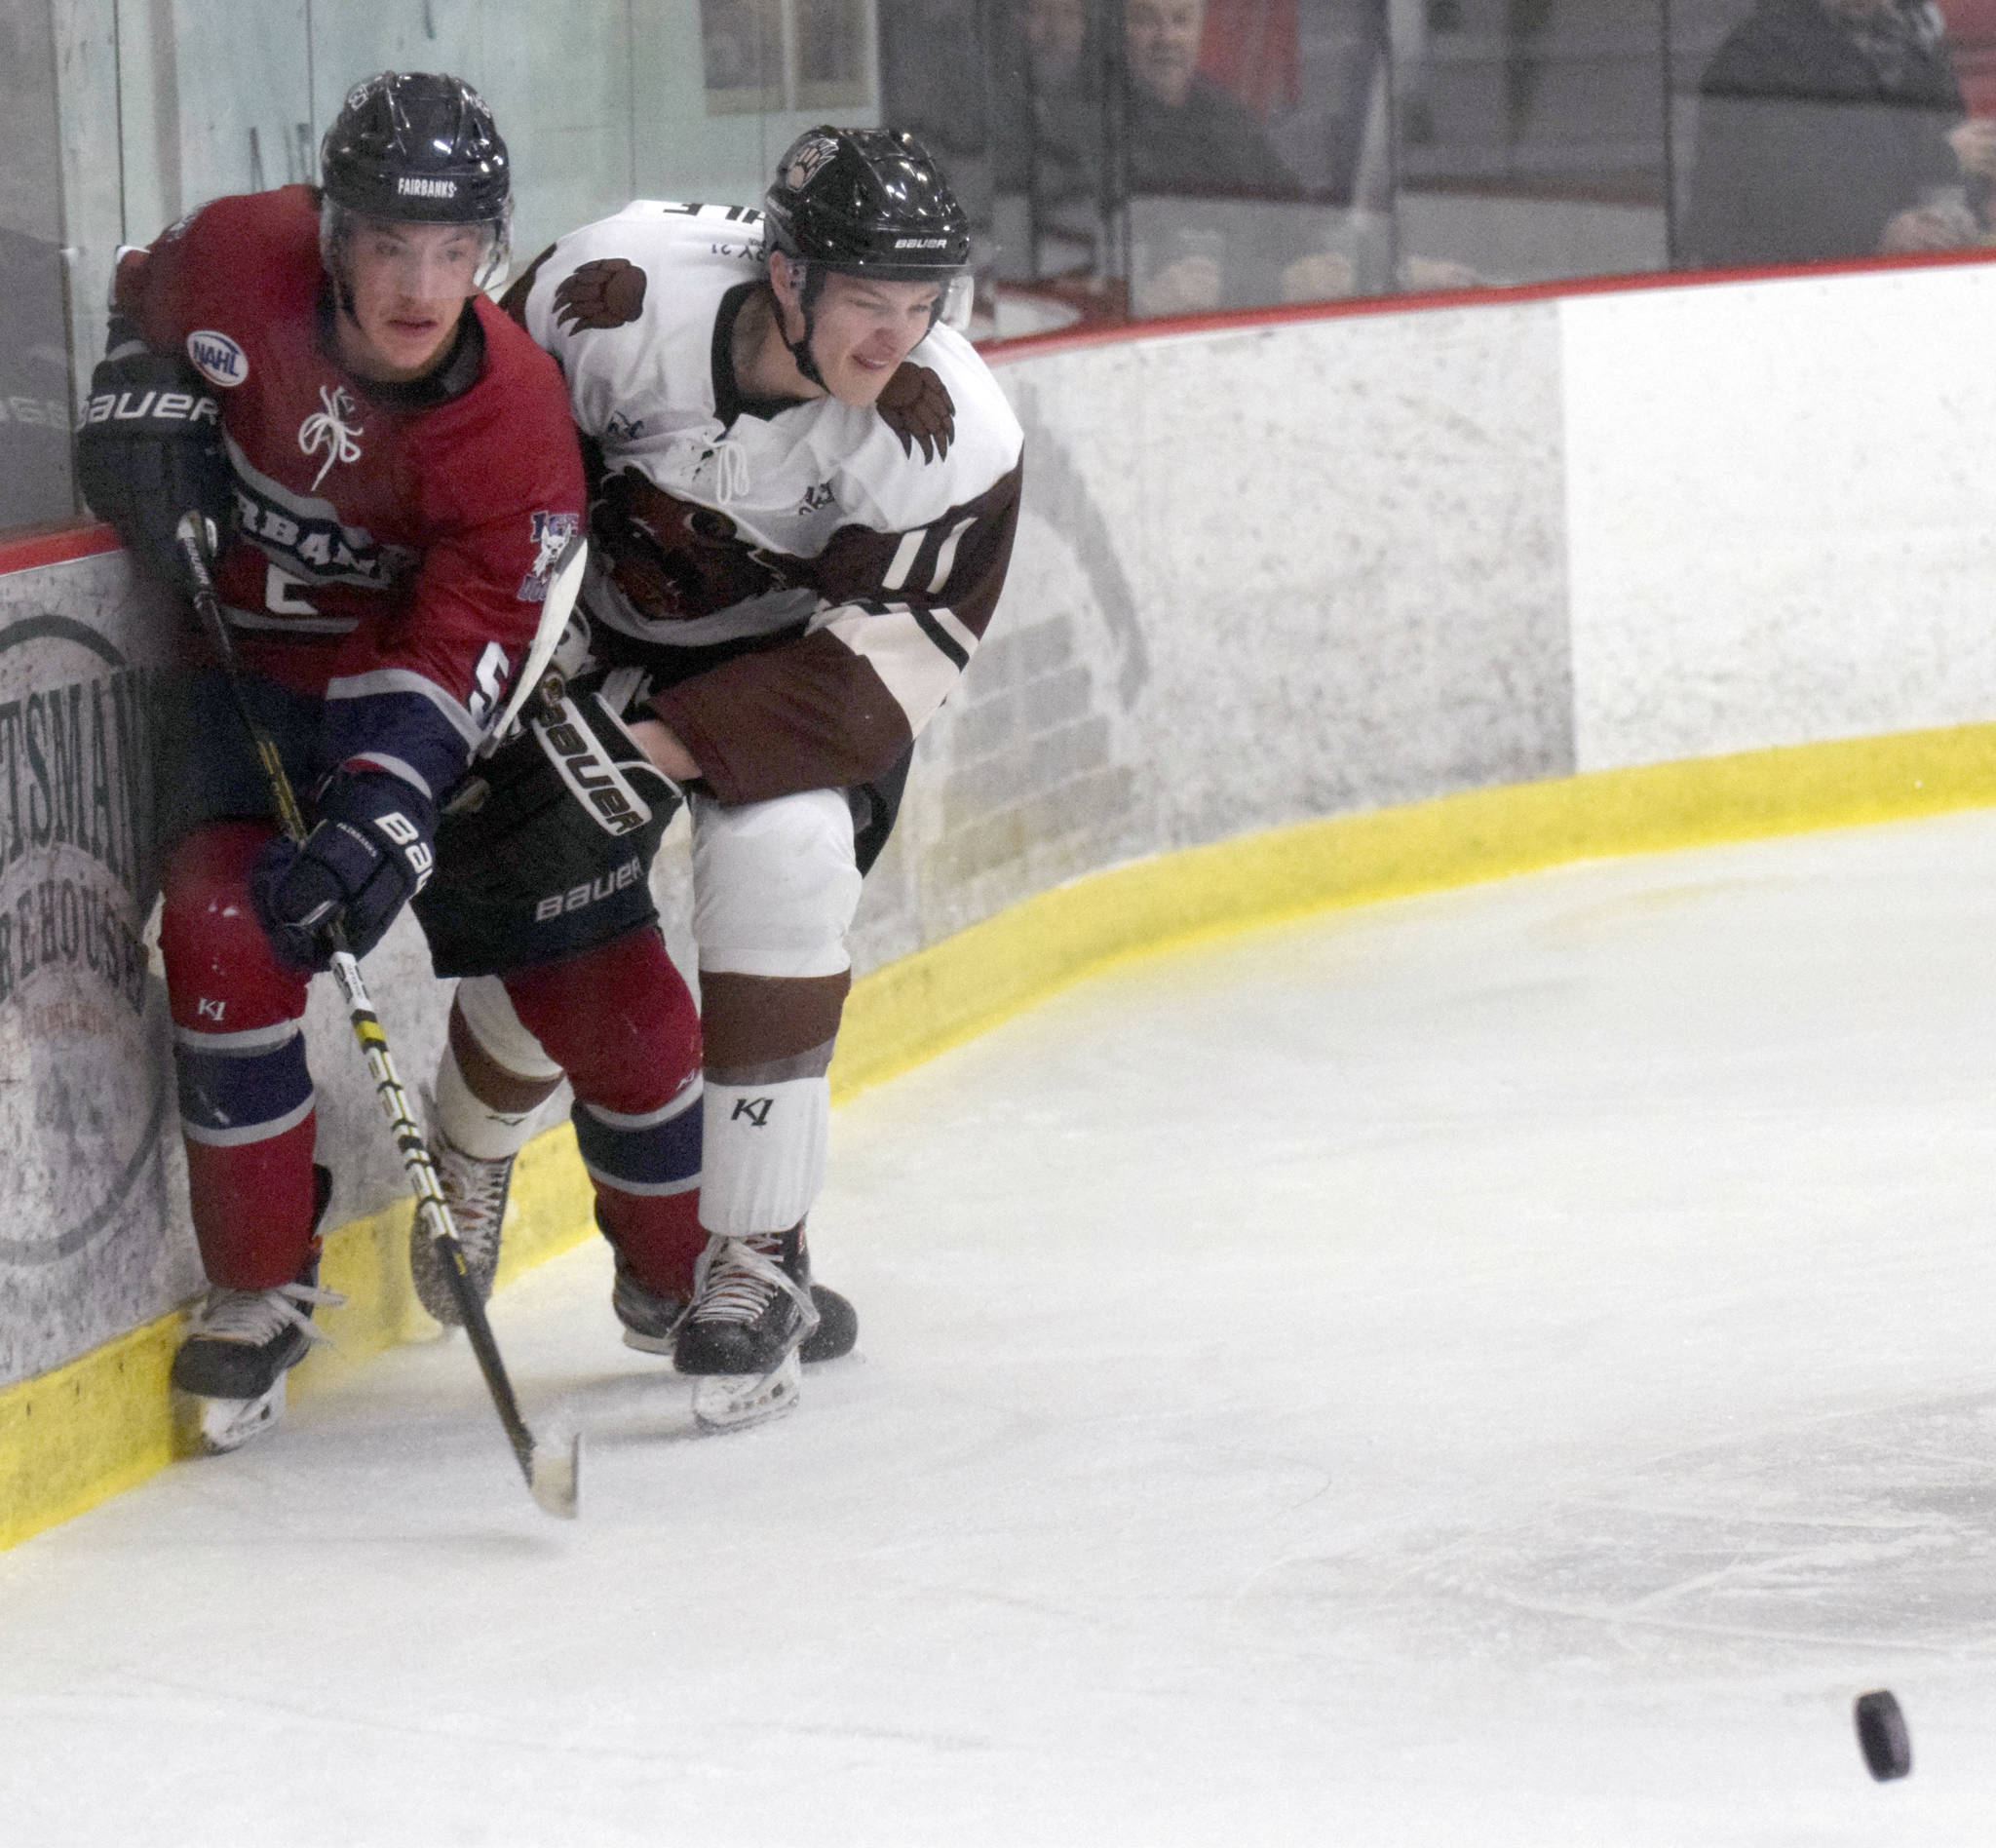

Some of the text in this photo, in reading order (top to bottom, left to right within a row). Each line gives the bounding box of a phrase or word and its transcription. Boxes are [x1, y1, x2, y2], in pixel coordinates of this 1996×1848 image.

[397, 177, 456, 199] FAIRBANKS
[894, 239, 948, 250] BAUER
[195, 342, 241, 378] NAHL
[535, 856, 646, 922] BAUER
